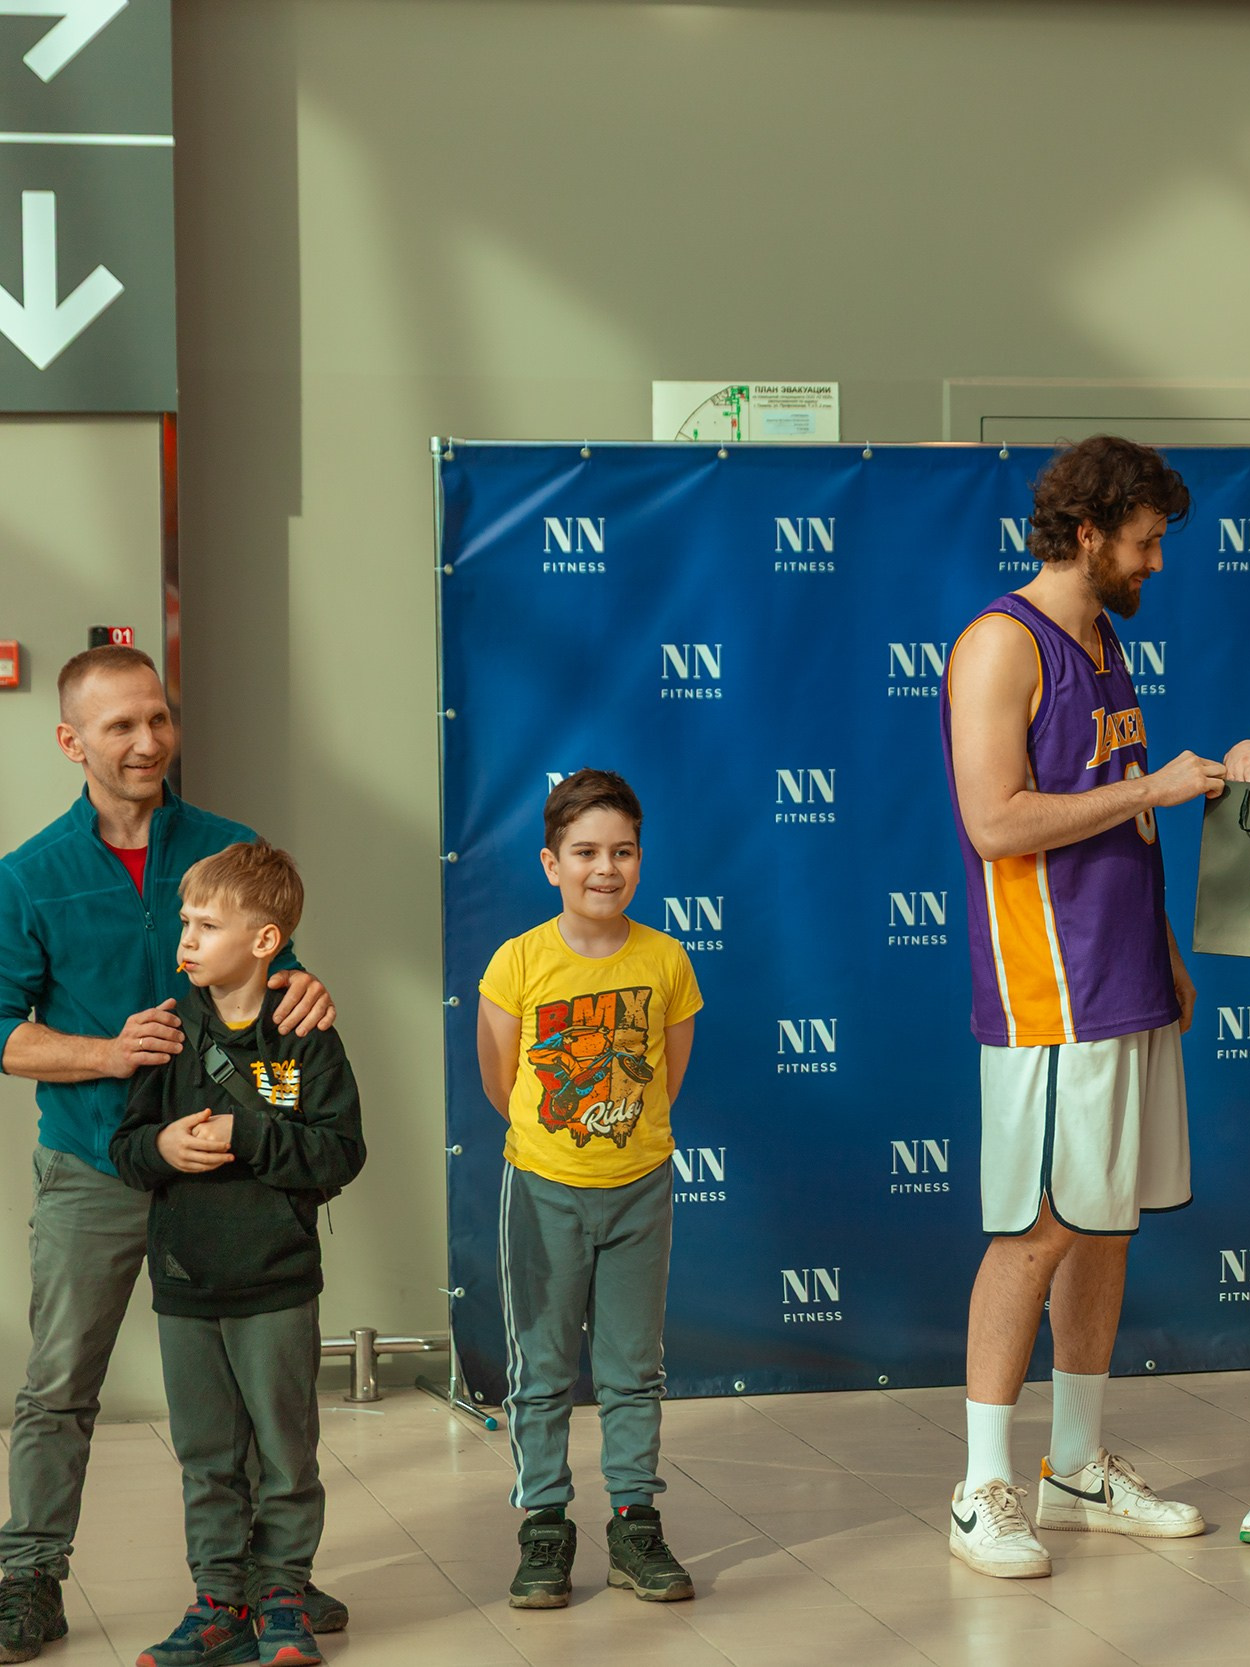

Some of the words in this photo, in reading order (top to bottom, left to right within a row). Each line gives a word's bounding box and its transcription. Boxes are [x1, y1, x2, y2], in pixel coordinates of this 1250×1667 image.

[755, 385, 778, 393] ПЛАН
[781, 385, 831, 394] ЭВАКУАЦИИ
[544, 518, 604, 552] NN
[775, 518, 835, 551] NN
[999, 517, 1033, 552] N
[544, 562, 605, 572] FITNESS
[775, 562, 834, 571] FITNESS
[999, 561, 1043, 572] FITNE
[112, 628, 131, 644] 01
[661, 644, 721, 678] NN
[888, 642, 947, 677] NN
[661, 689, 721, 698] FITNESS
[888, 686, 938, 697] FITNES
[776, 769, 835, 803] NN
[776, 813, 835, 822] FITNESS
[663, 896, 724, 931] NN
[889, 892, 947, 926] NN
[889, 935, 946, 945] FITNESS
[537, 988, 652, 1042] BMX
[778, 1019, 836, 1053] NN
[778, 1063, 836, 1073] FITNESS
[891, 1139, 949, 1174] NN
[891, 1183, 949, 1193] FITNESS
[675, 1191, 726, 1202] ITNESS
[781, 1268, 840, 1303] NN
[784, 1312, 842, 1322] FITNESS
